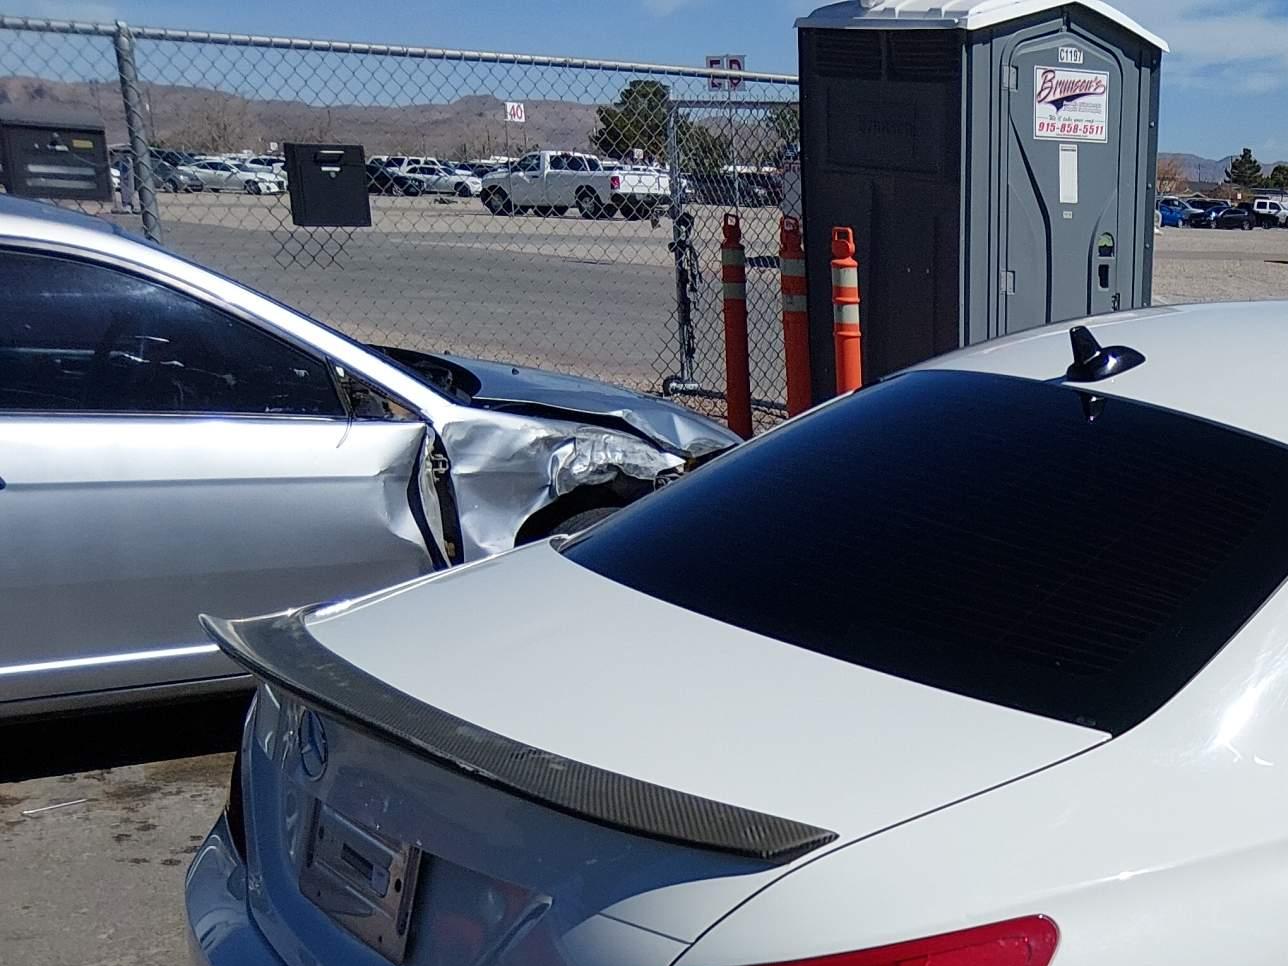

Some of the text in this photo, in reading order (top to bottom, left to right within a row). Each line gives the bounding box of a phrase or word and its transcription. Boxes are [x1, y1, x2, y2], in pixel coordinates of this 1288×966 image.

[1059, 48, 1084, 62] C1197
[510, 104, 522, 119] 40
[1038, 121, 1104, 136] 915-858-5511
